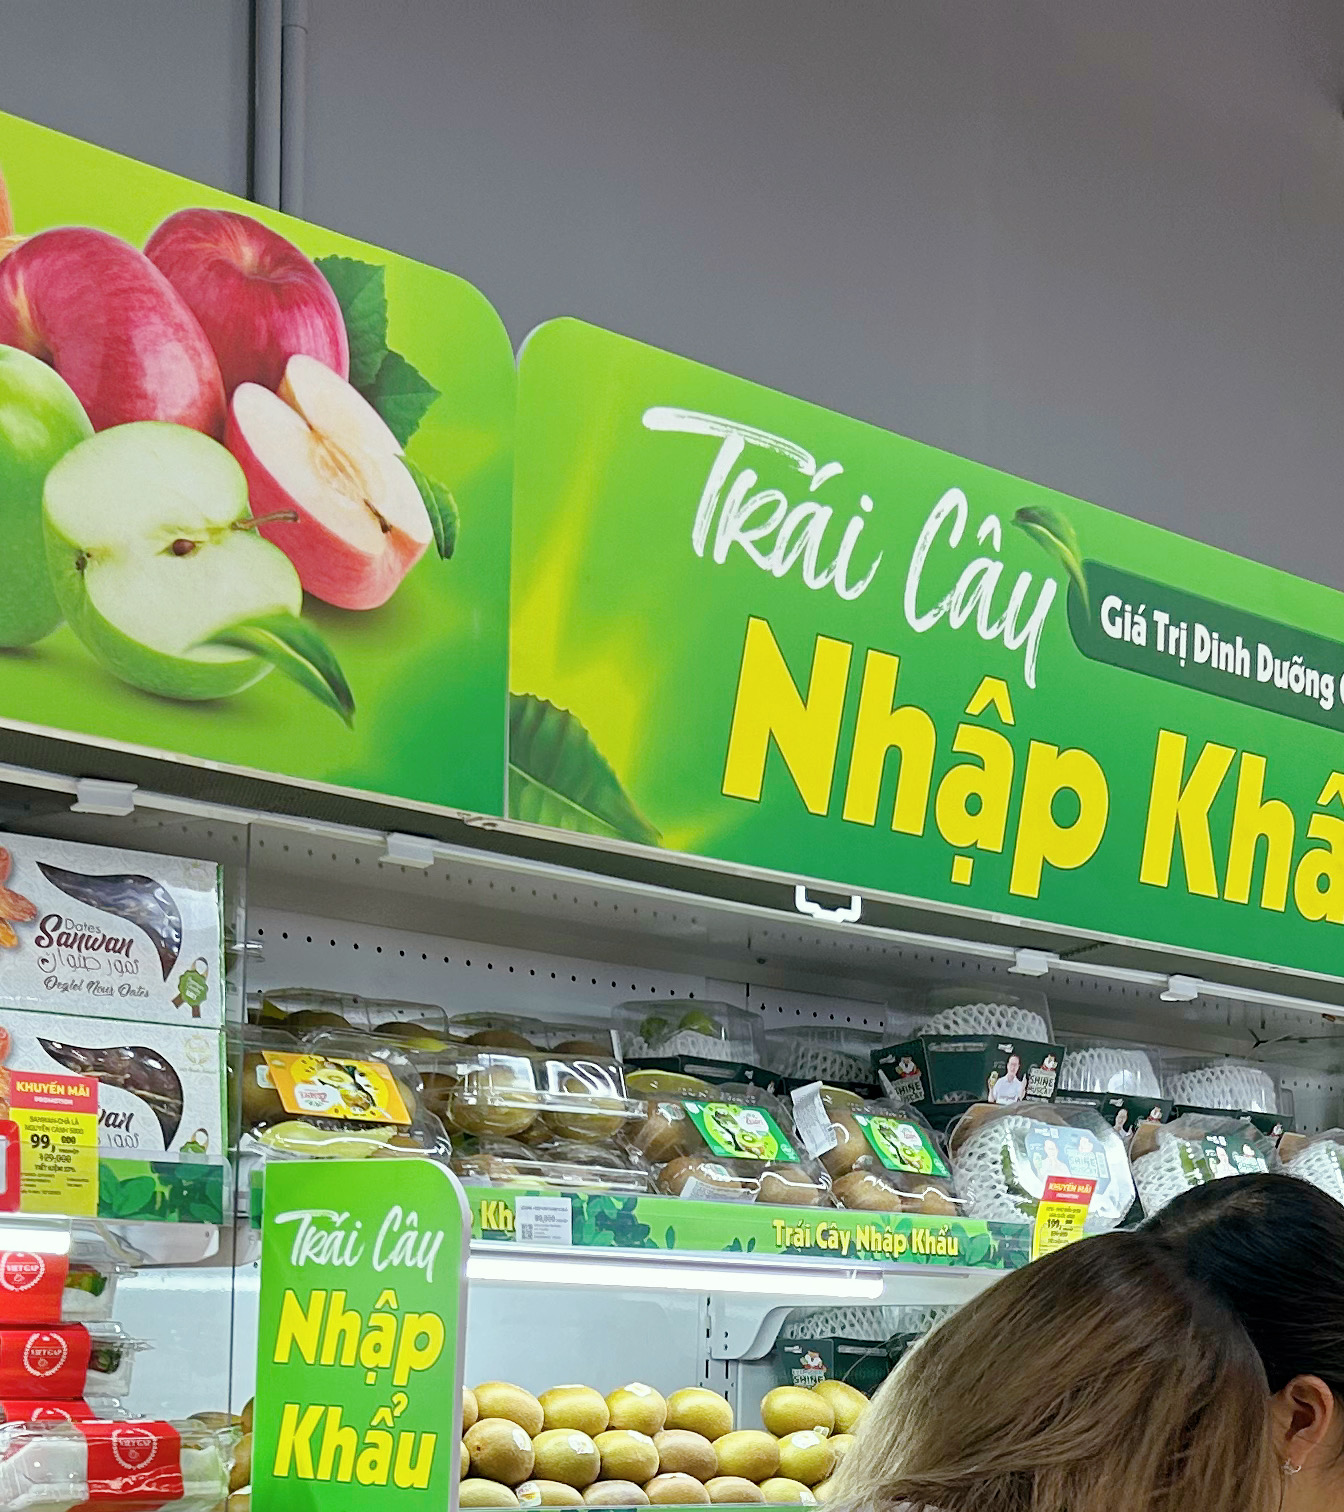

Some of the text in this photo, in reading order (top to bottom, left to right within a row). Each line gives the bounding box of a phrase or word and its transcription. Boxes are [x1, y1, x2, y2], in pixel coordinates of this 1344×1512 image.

[643, 406, 1058, 689] Trái Cây
[1100, 595, 1147, 647] Giá
[1153, 609, 1188, 667] Trị
[1193, 623, 1251, 678] Dinh
[1256, 643, 1335, 711] Dưỡng
[721, 615, 1109, 900] Nhập
[34, 913, 134, 958] Sanwan
[64, 918, 101, 934] Dates
[274, 1209, 365, 1268] Trái
[371, 1205, 445, 1282] Cây
[772, 1219, 960, 1260] Trái Cây Nhập Khẩu
[273, 1288, 446, 1387] Nhập
[273, 1392, 437, 1490] Khẩu
